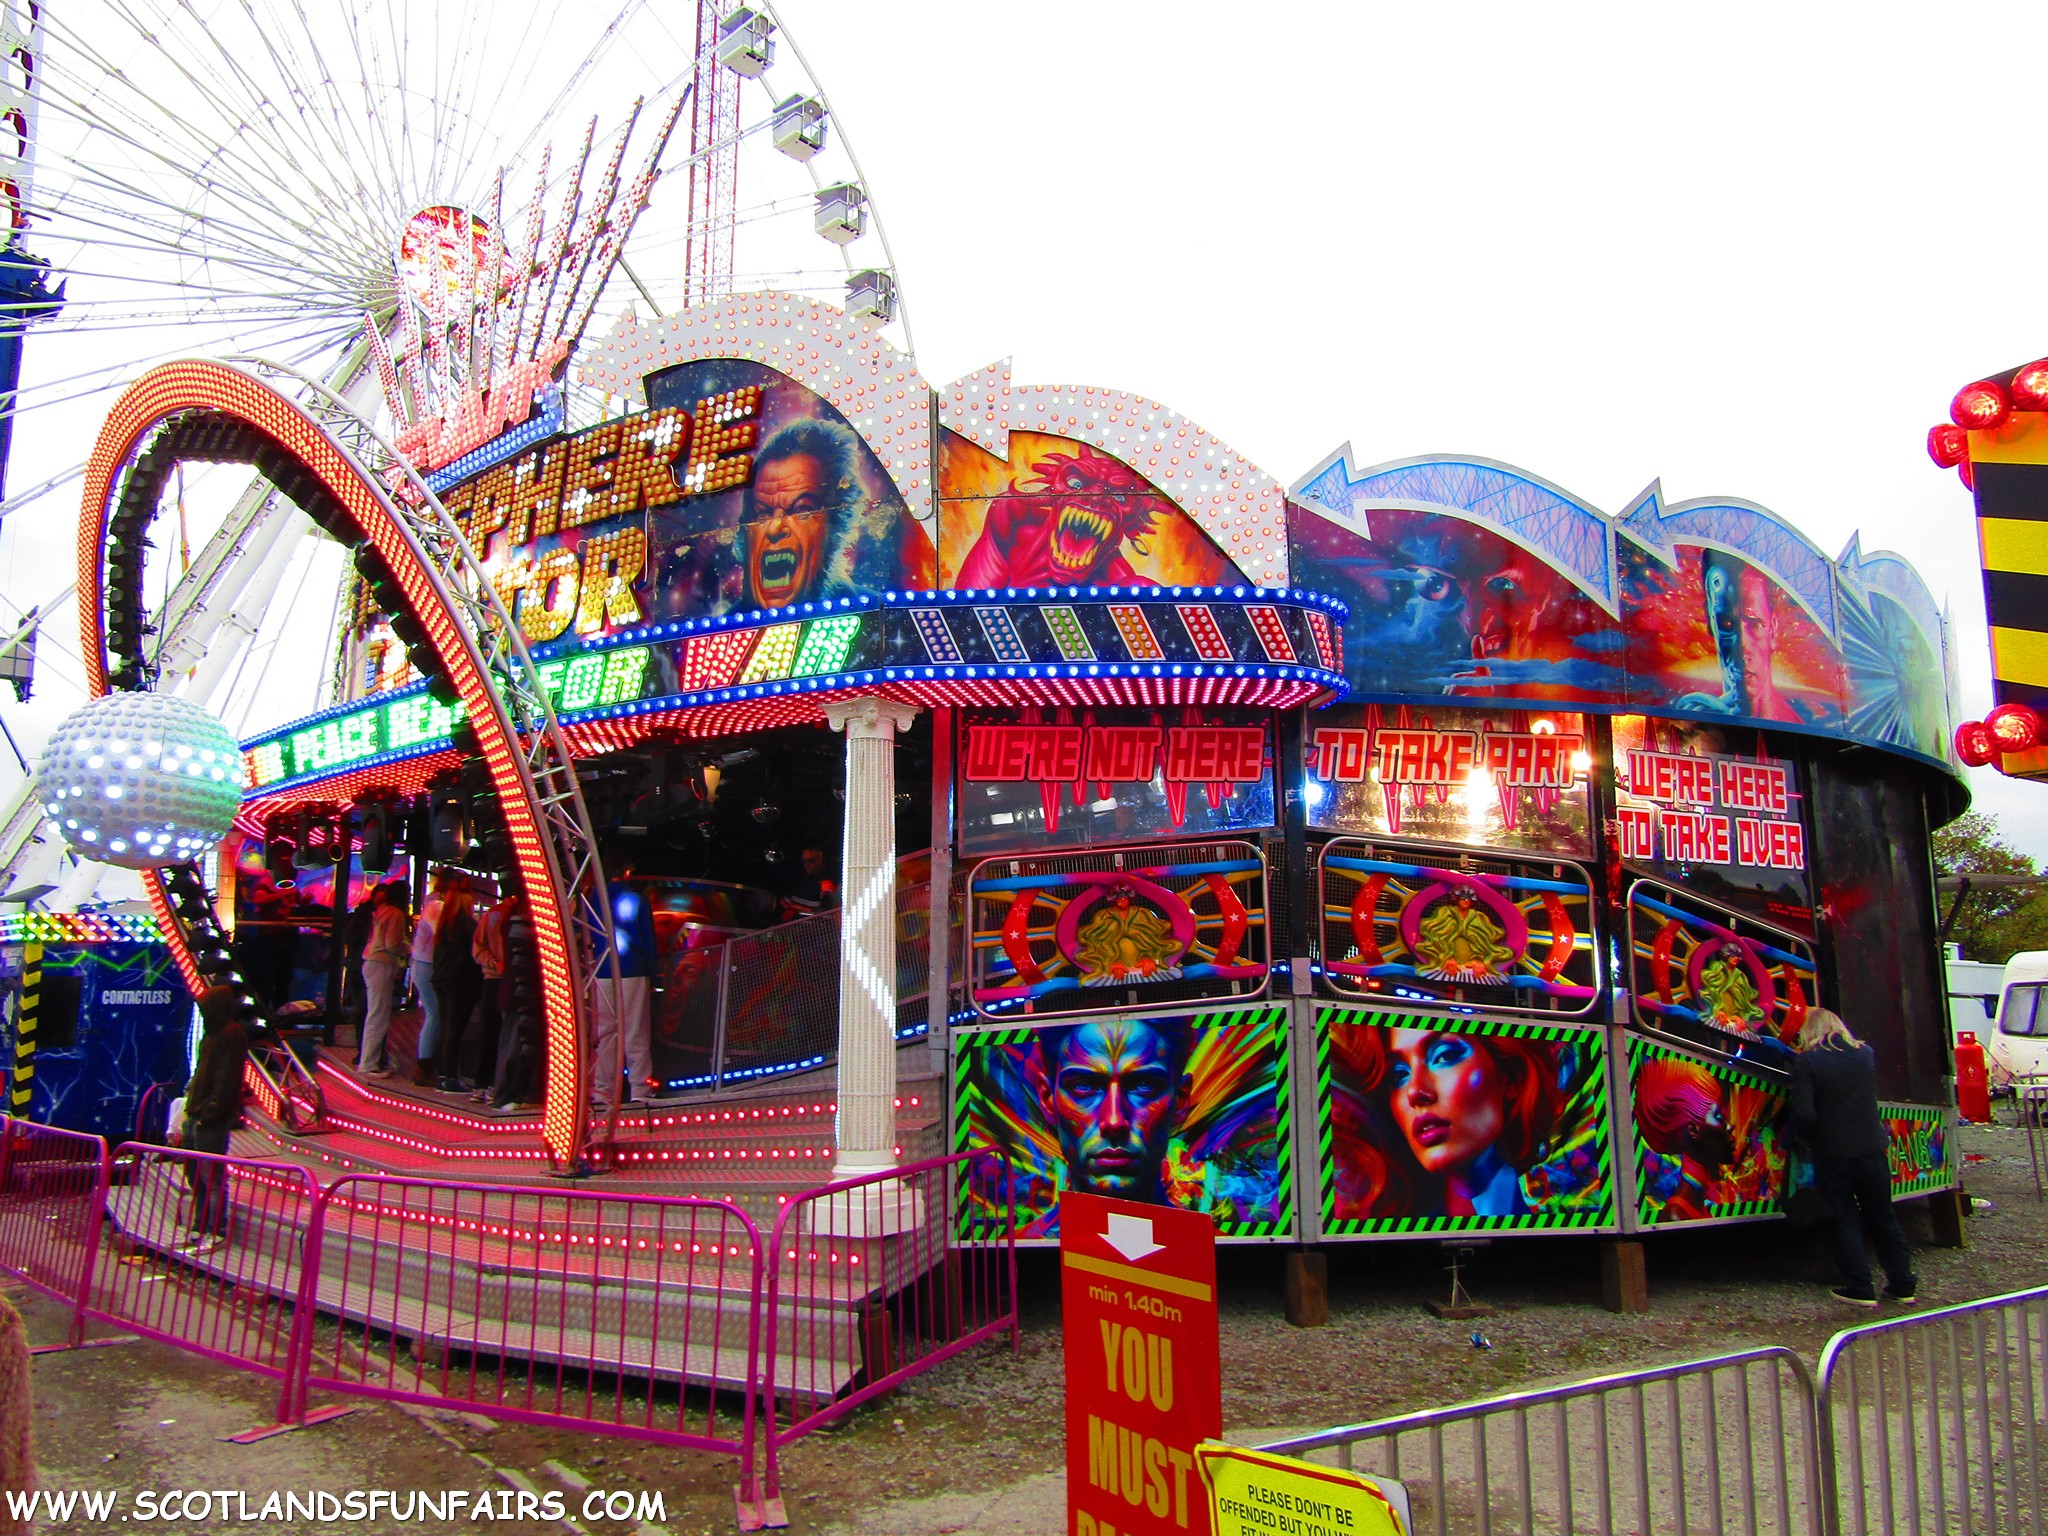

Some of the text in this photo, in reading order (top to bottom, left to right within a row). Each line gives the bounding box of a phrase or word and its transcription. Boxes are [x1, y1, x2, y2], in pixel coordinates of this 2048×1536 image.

[533, 647, 649, 714] FOR
[683, 615, 861, 693] WAR
[965, 726, 1266, 782] WE'RE NOT HERE
[1314, 728, 1584, 788] TO TAKE PART
[1627, 749, 1788, 813] WE'RE HERE
[1616, 807, 1804, 870] TO TAKE OVER
[102, 990, 171, 1005] CONTACTLESS
[1089, 1284, 1182, 1322] min 1.40m
[1099, 1318, 1174, 1412] YOU
[1088, 1414, 1193, 1529] MUST
[1219, 1497, 1277, 1528] OFFENDED
[1279, 1514, 1302, 1536] BUT
[1247, 1484, 1354, 1527] PLEASE DON'T BE
